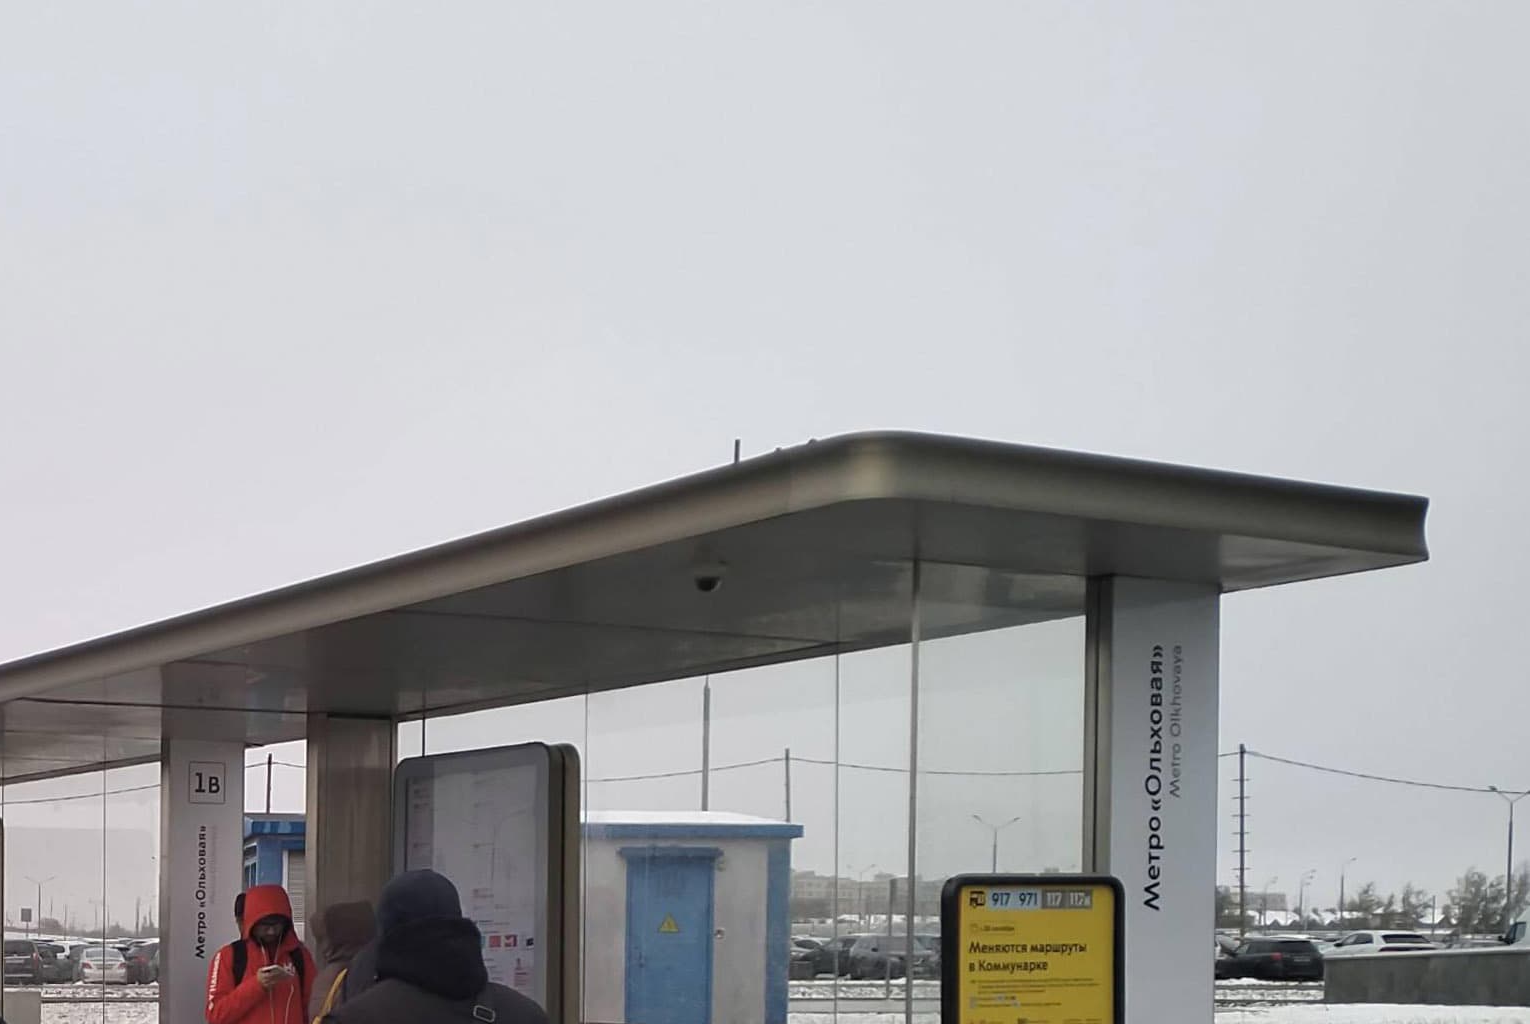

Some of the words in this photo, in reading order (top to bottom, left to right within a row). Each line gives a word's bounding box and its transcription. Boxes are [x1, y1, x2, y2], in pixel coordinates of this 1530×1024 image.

[1169, 645, 1184, 738] Olkhovaya
[1145, 644, 1164, 811] «Ольховая»
[1169, 743, 1182, 798] Metro
[195, 825, 207, 908] «Ольховая»
[1143, 816, 1165, 911] Метро
[992, 892, 1011, 907] 917
[1019, 892, 1038, 907] 971
[195, 911, 207, 959] Метро
[969, 941, 1028, 953] Меняются
[1030, 943, 1087, 956] маршруты
[969, 962, 976, 972] в
[978, 960, 1048, 974] Коммунарке
